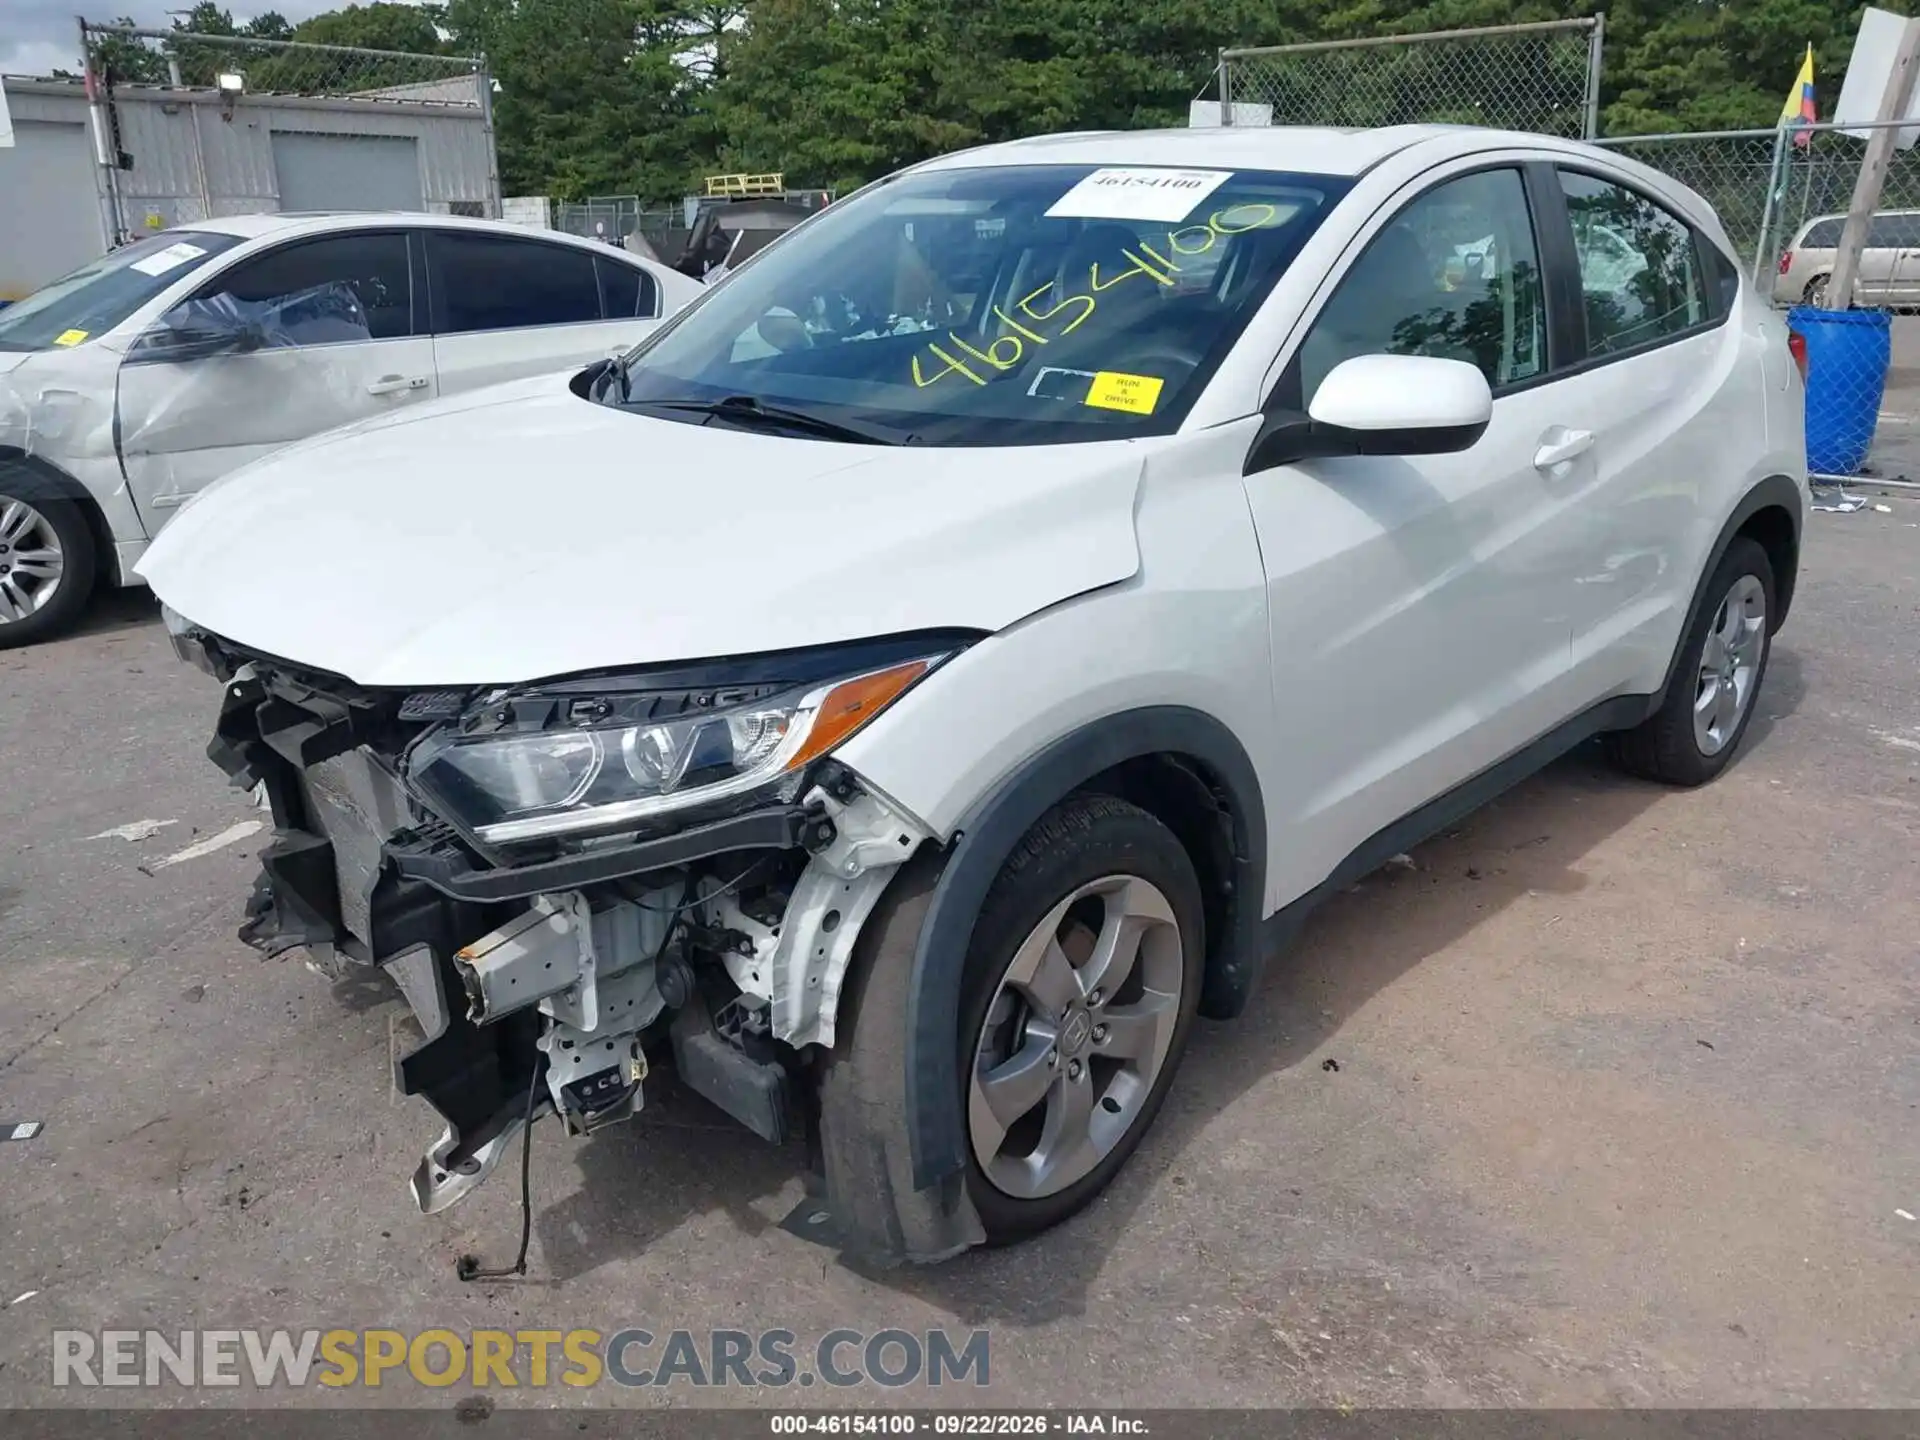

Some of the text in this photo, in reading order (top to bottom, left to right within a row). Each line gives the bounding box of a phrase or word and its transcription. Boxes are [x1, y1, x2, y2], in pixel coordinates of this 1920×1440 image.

[911, 204, 1275, 388] 46154100
[1116, 378, 1141, 388] RUN
[1104, 394, 1138, 406] DRIVE
